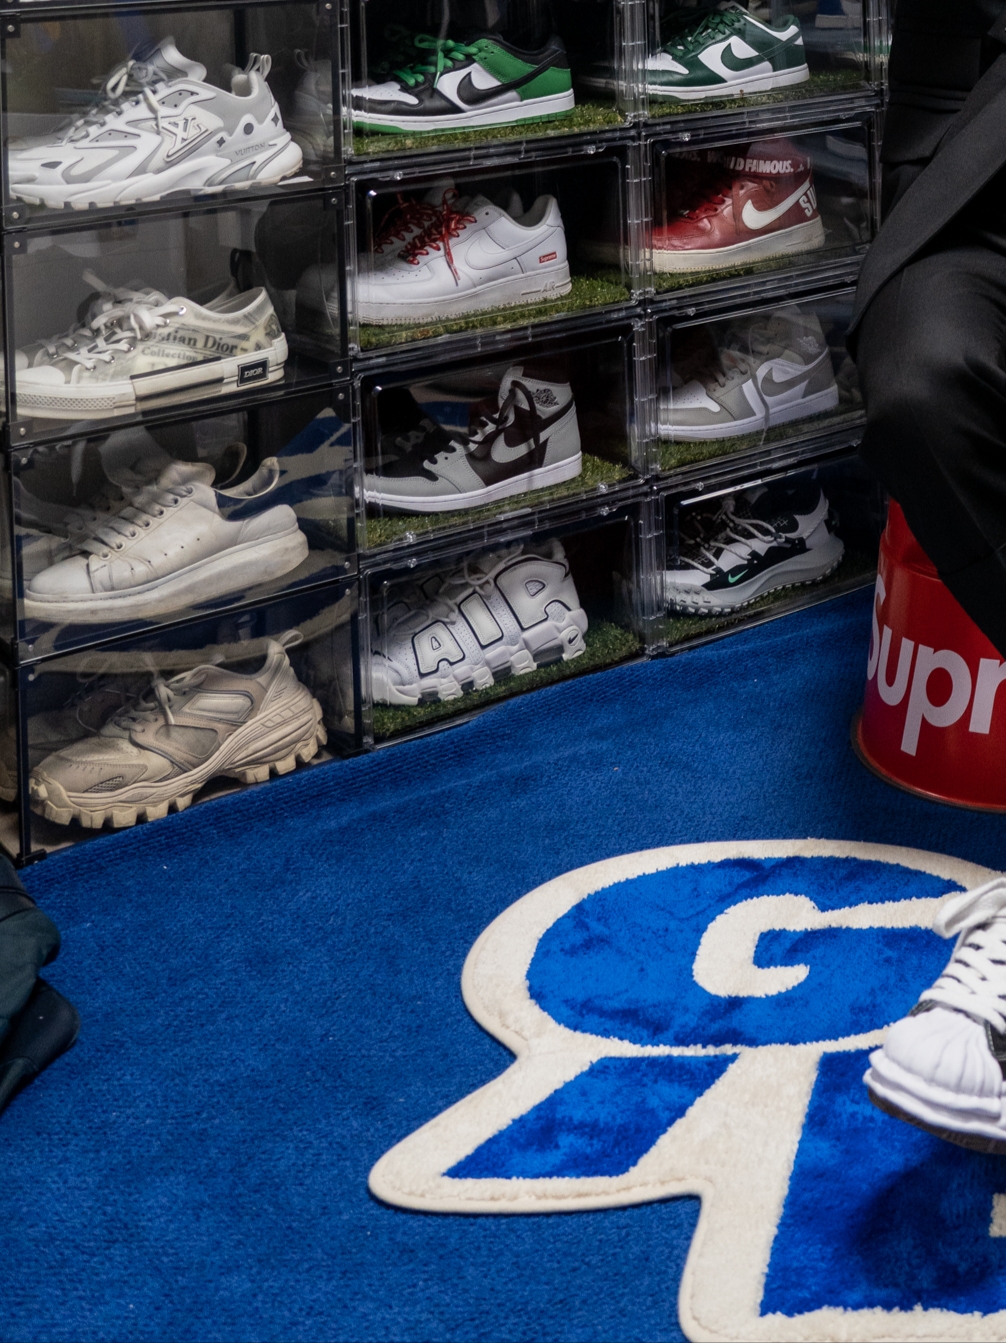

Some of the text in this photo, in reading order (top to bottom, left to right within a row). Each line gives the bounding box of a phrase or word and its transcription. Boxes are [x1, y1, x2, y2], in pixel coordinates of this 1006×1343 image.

[234, 142, 266, 156] VUITTON
[540, 252, 557, 262] Supreme
[541, 281, 556, 294] AIR
[203, 334, 238, 354] Dior
[141, 347, 198, 362] Collection
[243, 367, 263, 378] DIOR
[411, 558, 572, 679] AIR
